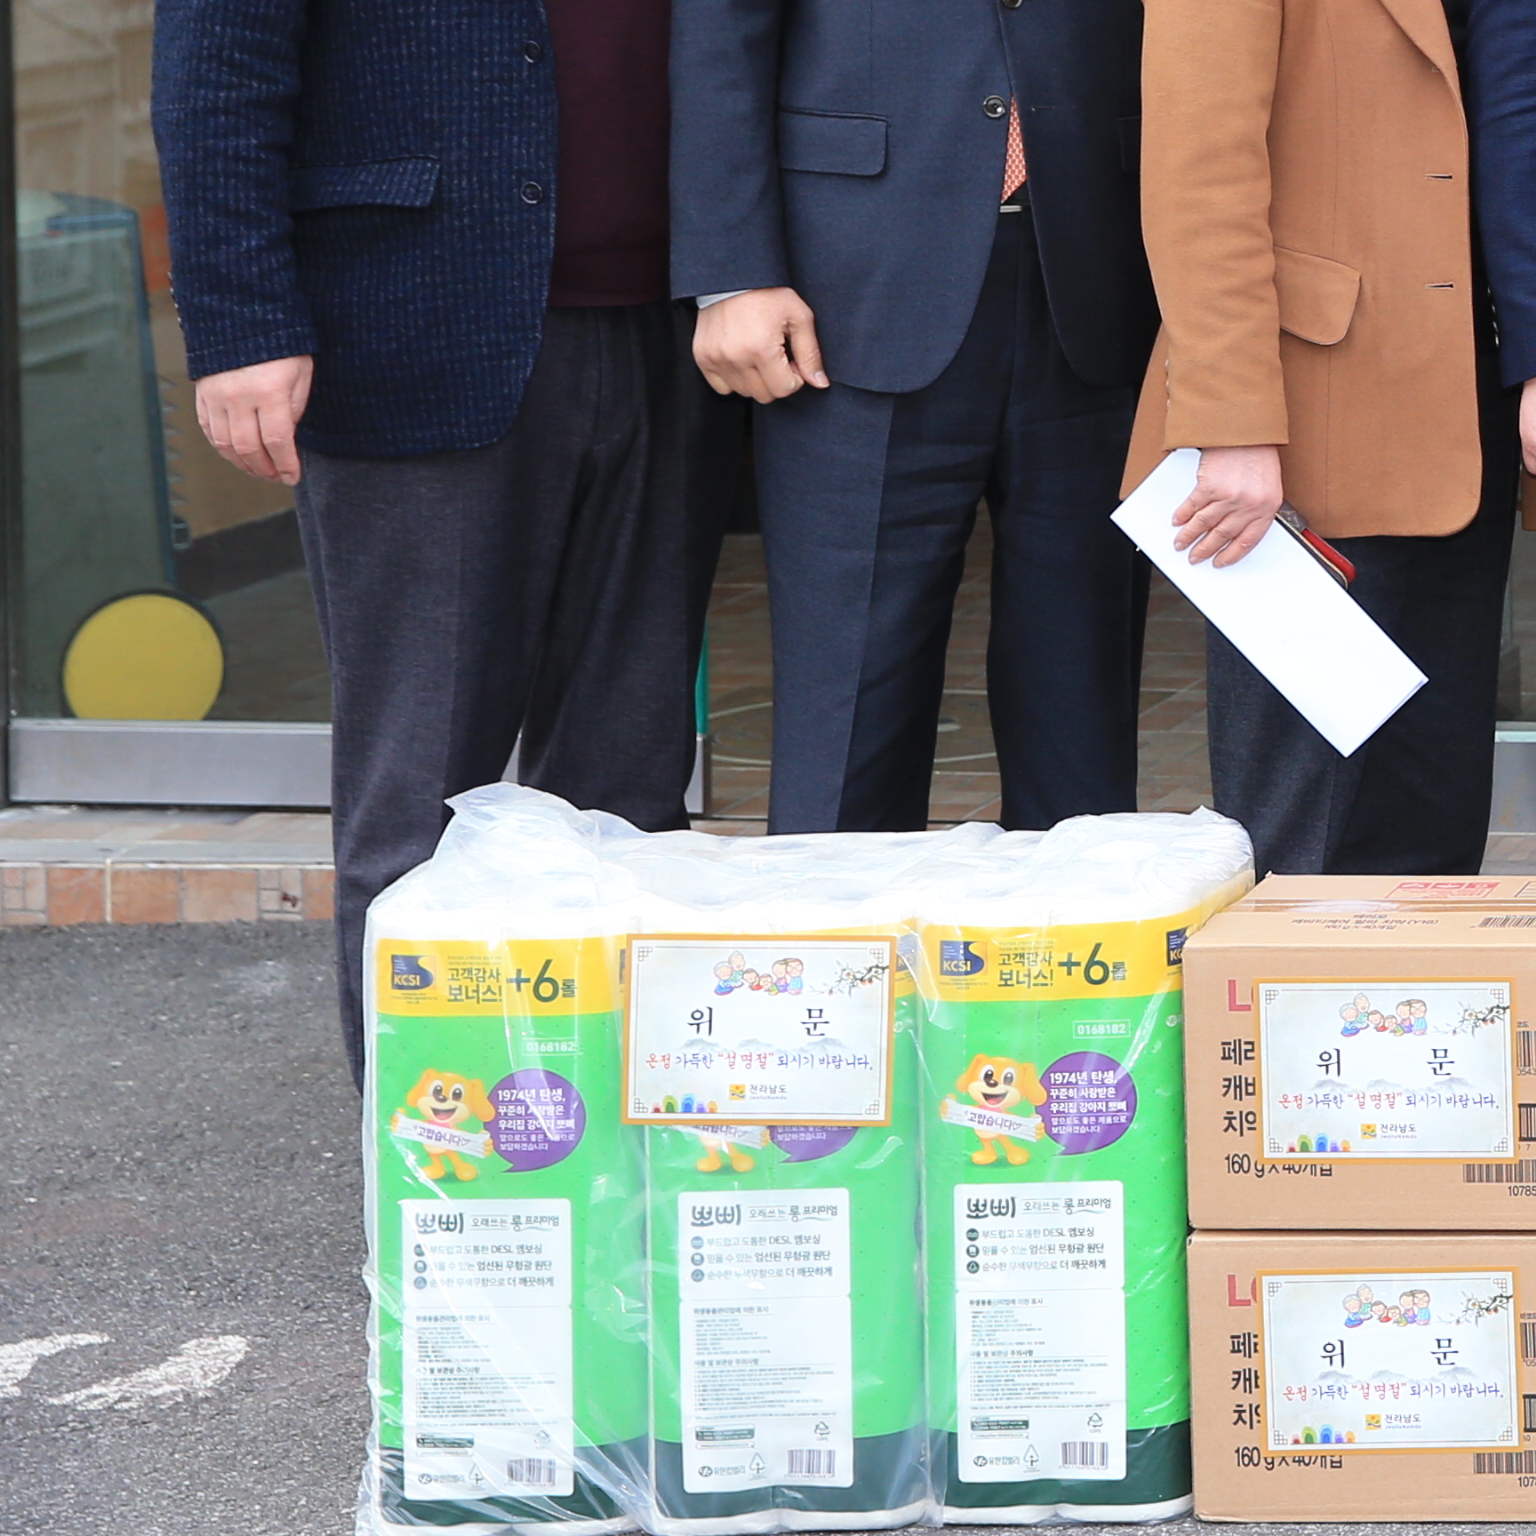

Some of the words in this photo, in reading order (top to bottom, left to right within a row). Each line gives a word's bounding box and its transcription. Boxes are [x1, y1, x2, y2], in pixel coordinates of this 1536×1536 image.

[943, 960, 971, 972] KCSI
[998, 952, 1053, 967] 고객감사
[447, 968, 500, 983] 고객감사
[998, 969, 1054, 988] 보너스!
[447, 985, 502, 1003] 보너스!
[687, 1007, 713, 1036] 위
[800, 1008, 830, 1036] 문
[1077, 1024, 1126, 1035] 0168182
[1316, 1048, 1341, 1077] 위
[1426, 1048, 1455, 1076] 문
[1320, 1339, 1345, 1369] 위
[1430, 1338, 1459, 1366] 문
